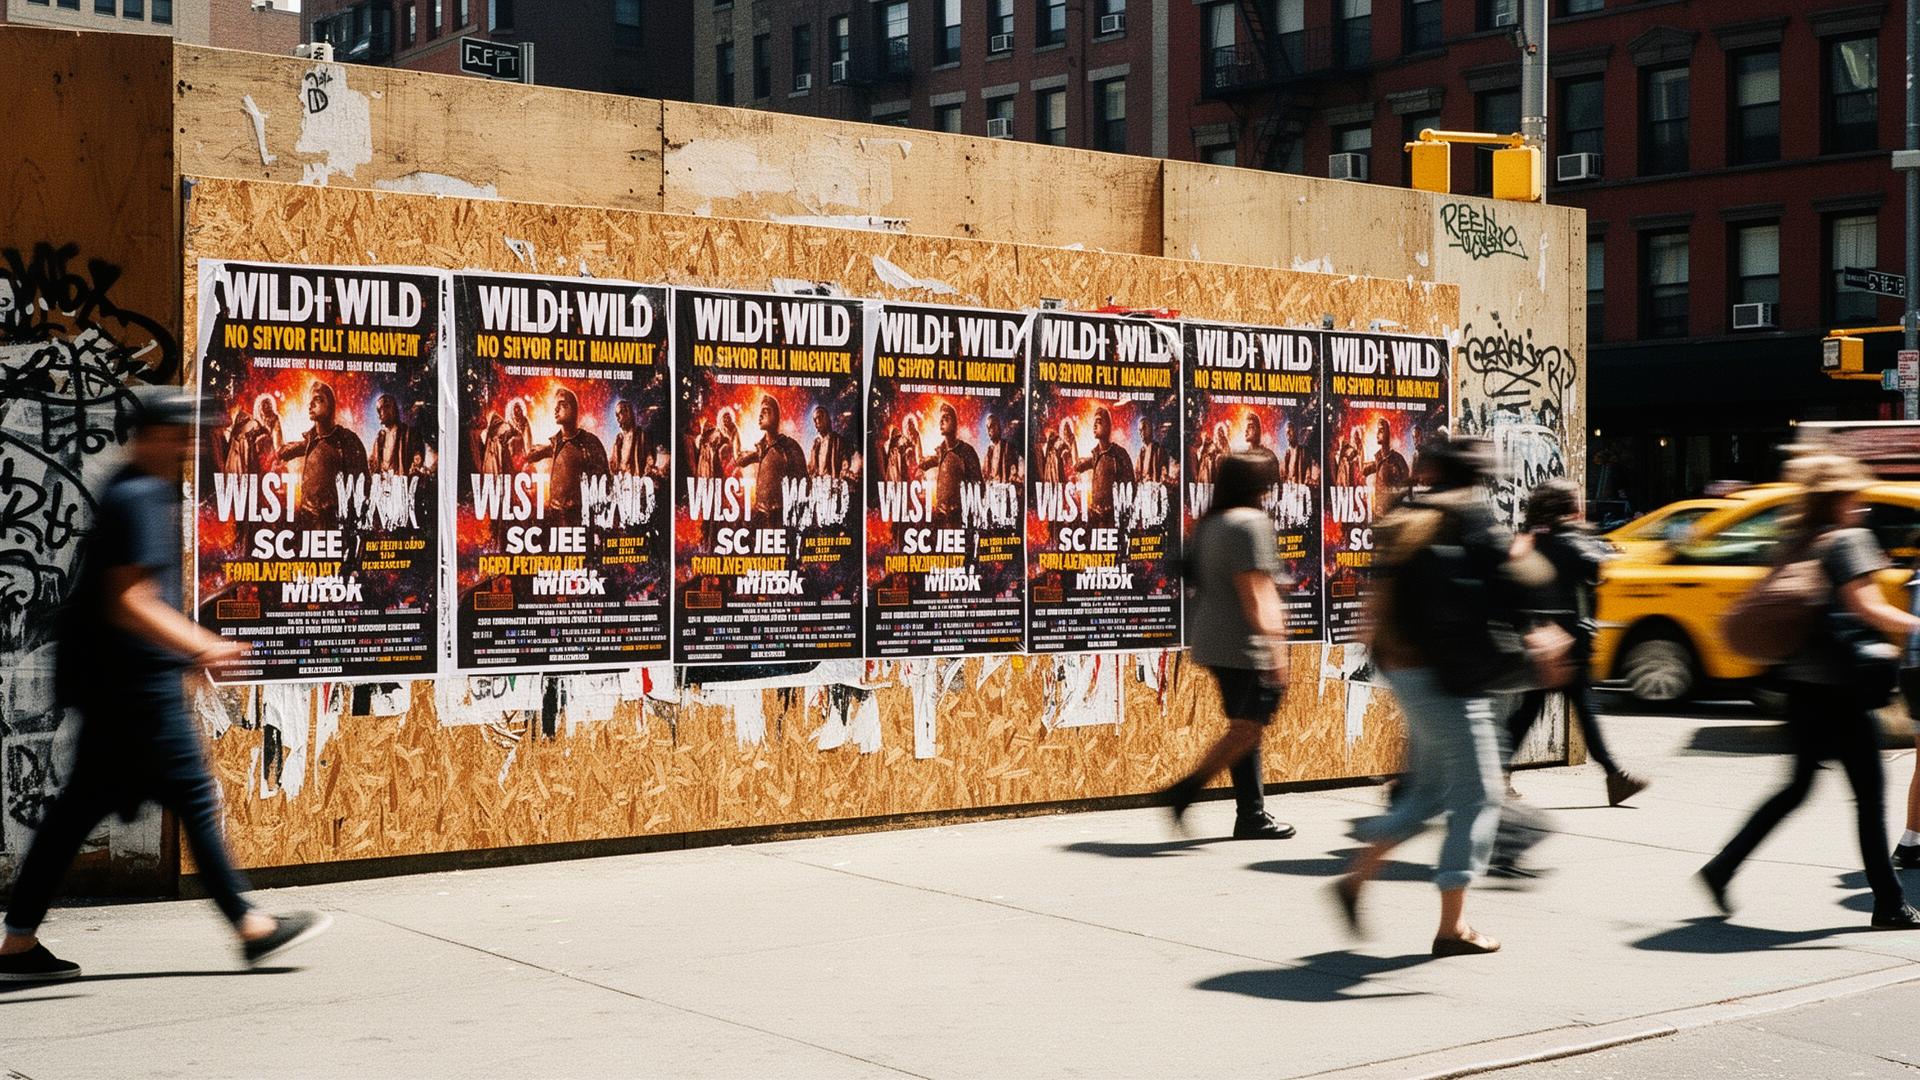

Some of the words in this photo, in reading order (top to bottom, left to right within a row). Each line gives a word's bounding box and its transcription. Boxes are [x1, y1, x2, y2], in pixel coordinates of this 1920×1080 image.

[335, 277, 422, 328] WILD
[577, 290, 653, 338] WILD
[224, 324, 249, 349] NO
[781, 302, 851, 346] WILD
[958, 317, 1020, 359] WILD
[477, 334, 499, 357] NO
[694, 344, 713, 366] NO
[1261, 333, 1313, 371] WILD
[1391, 340, 1440, 377] WILD
[878, 356, 895, 377] NO
[1195, 369, 1209, 388] NO
[1333, 376, 1346, 395] NO
